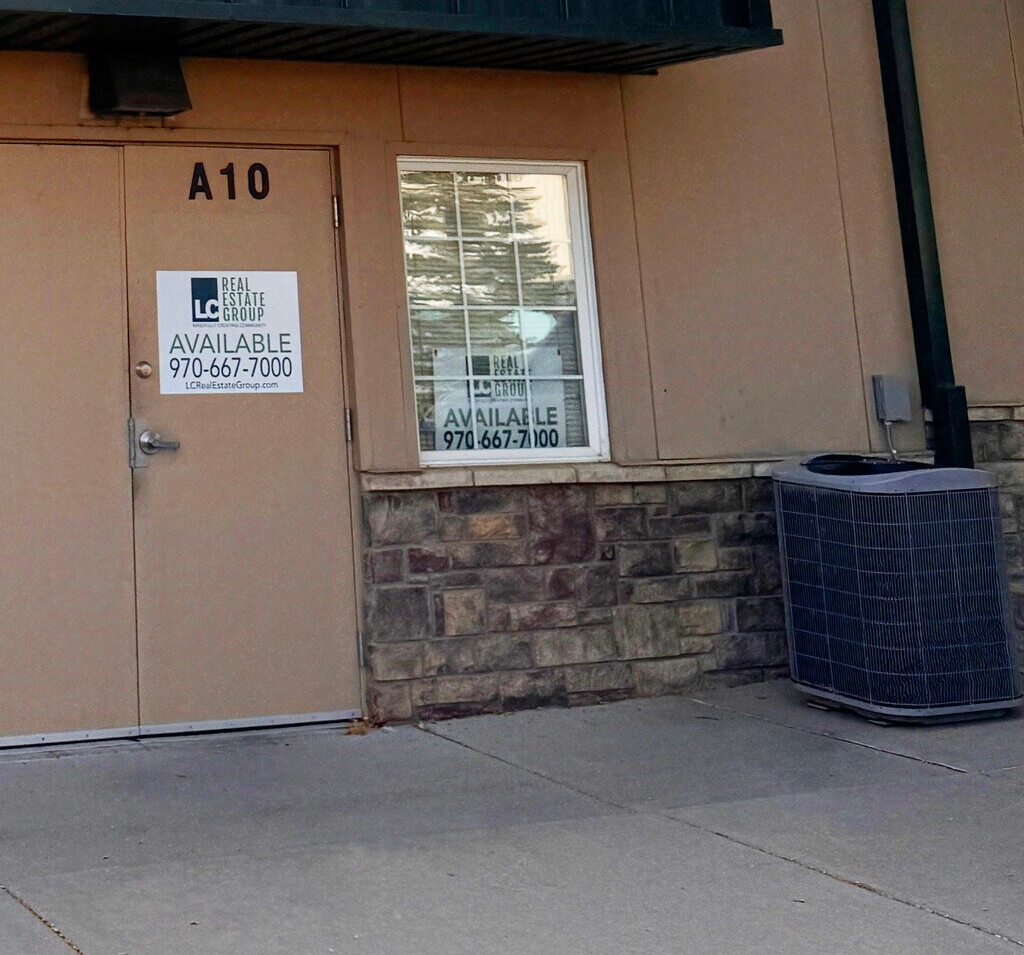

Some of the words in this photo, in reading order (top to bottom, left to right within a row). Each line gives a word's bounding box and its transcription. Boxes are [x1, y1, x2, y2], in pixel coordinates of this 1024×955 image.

[188, 162, 270, 200] A10
[222, 277, 251, 292] REAL
[222, 292, 266, 307] ESTATE
[194, 298, 220, 319] LC
[223, 306, 265, 322] GROUP
[169, 333, 292, 354] AVAILABLE
[169, 357, 293, 378] 970-667-7000
[493, 355, 519, 369] REAL
[494, 368, 532, 383] ESTAT
[185, 381, 279, 390] LCRealEstateGroup.com
[495, 382, 532, 397] GROU
